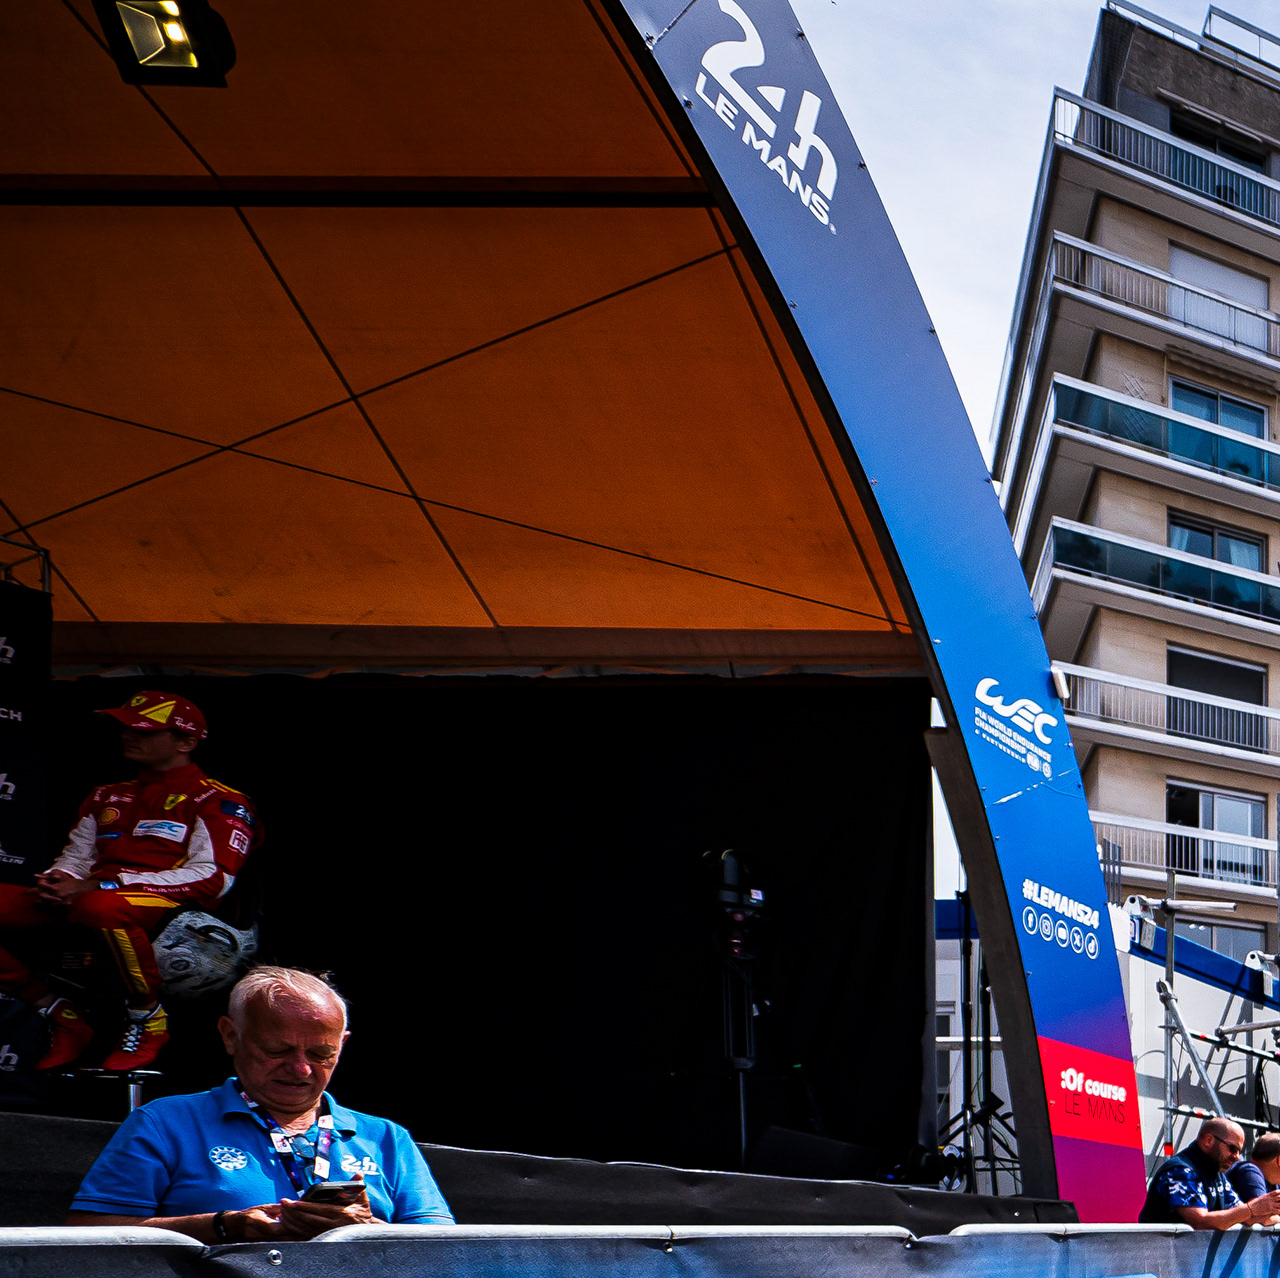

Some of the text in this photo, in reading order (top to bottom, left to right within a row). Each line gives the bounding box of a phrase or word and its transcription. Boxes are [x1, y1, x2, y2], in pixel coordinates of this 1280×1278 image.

[700, 0, 839, 200] 24h
[695, 72, 830, 226] LE MANS
[974, 716, 1027, 755] CHAMPIONSHIP
[975, 677, 1058, 745] WEC
[987, 714, 1013, 738] WORLD
[1012, 731, 1052, 763] ENDURANCE
[1022, 878, 1100, 929] #LEMANS24
[1064, 1092, 1126, 1124] LE MANS
[1085, 1078, 1127, 1102] course
